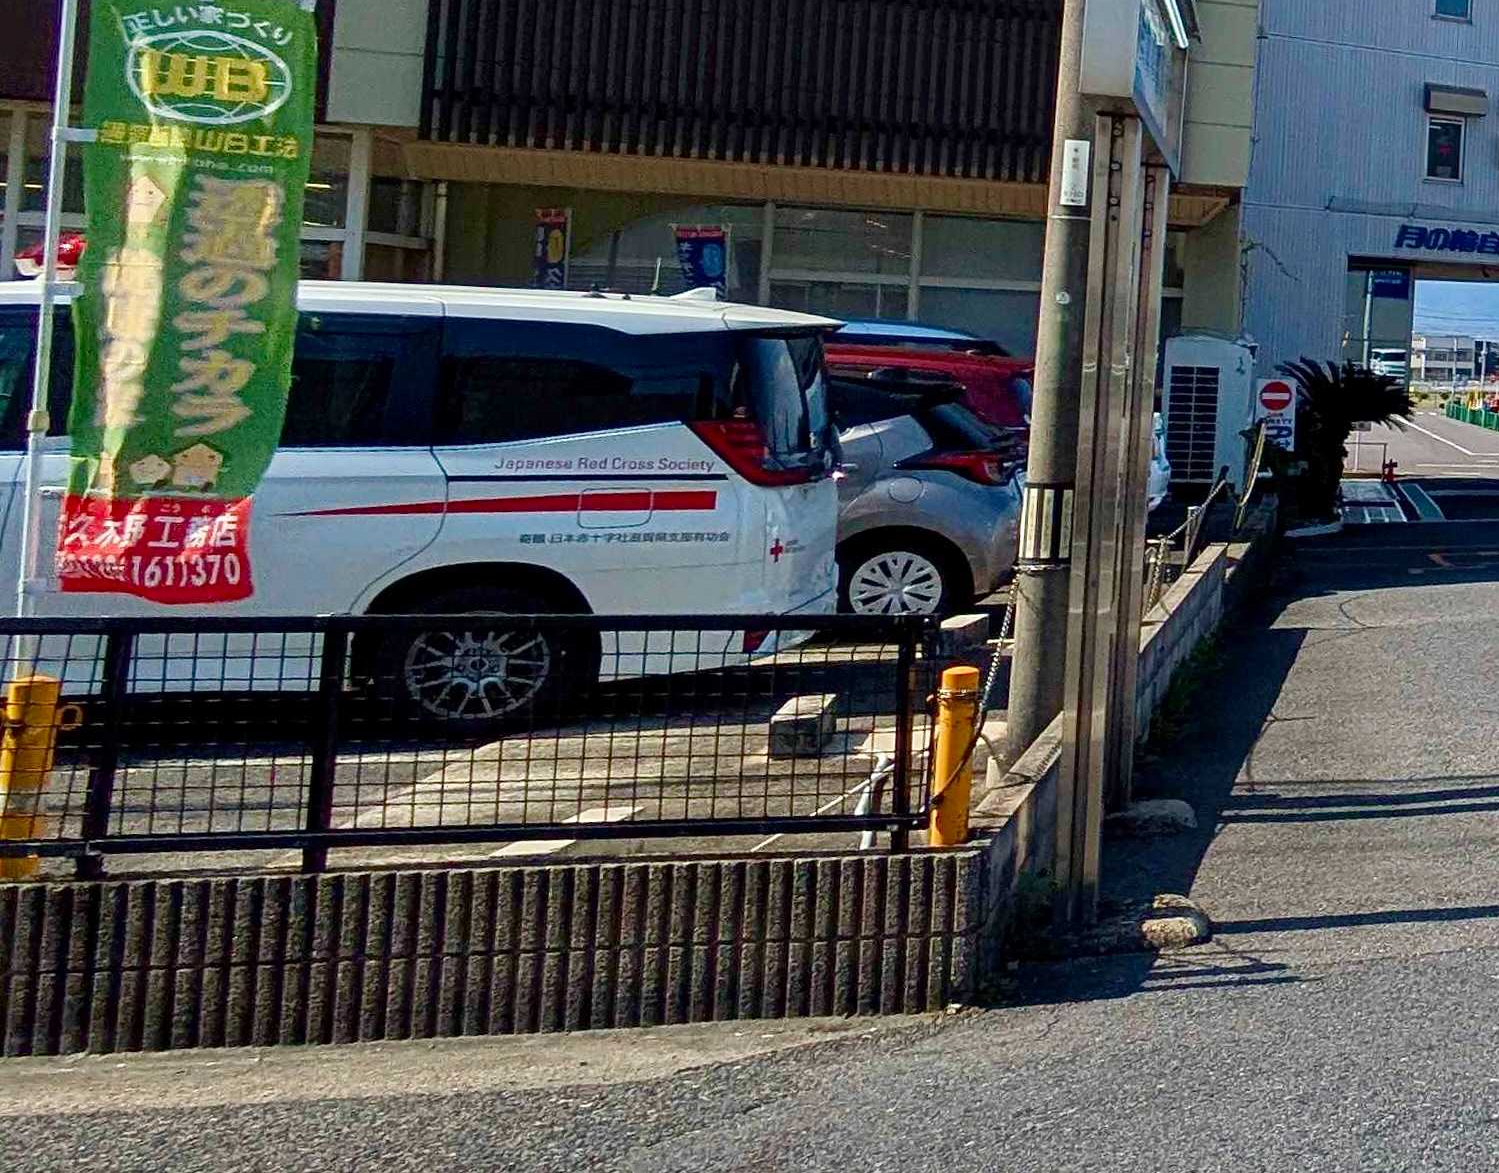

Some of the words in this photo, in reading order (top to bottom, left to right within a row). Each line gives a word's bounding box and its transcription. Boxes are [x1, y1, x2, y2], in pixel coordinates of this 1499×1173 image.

[140, 48, 268, 103] WB
[494, 457, 574, 473] Japanese
[577, 457, 609, 471] Red
[611, 456, 655, 471] Cross
[658, 456, 716, 473] Society
